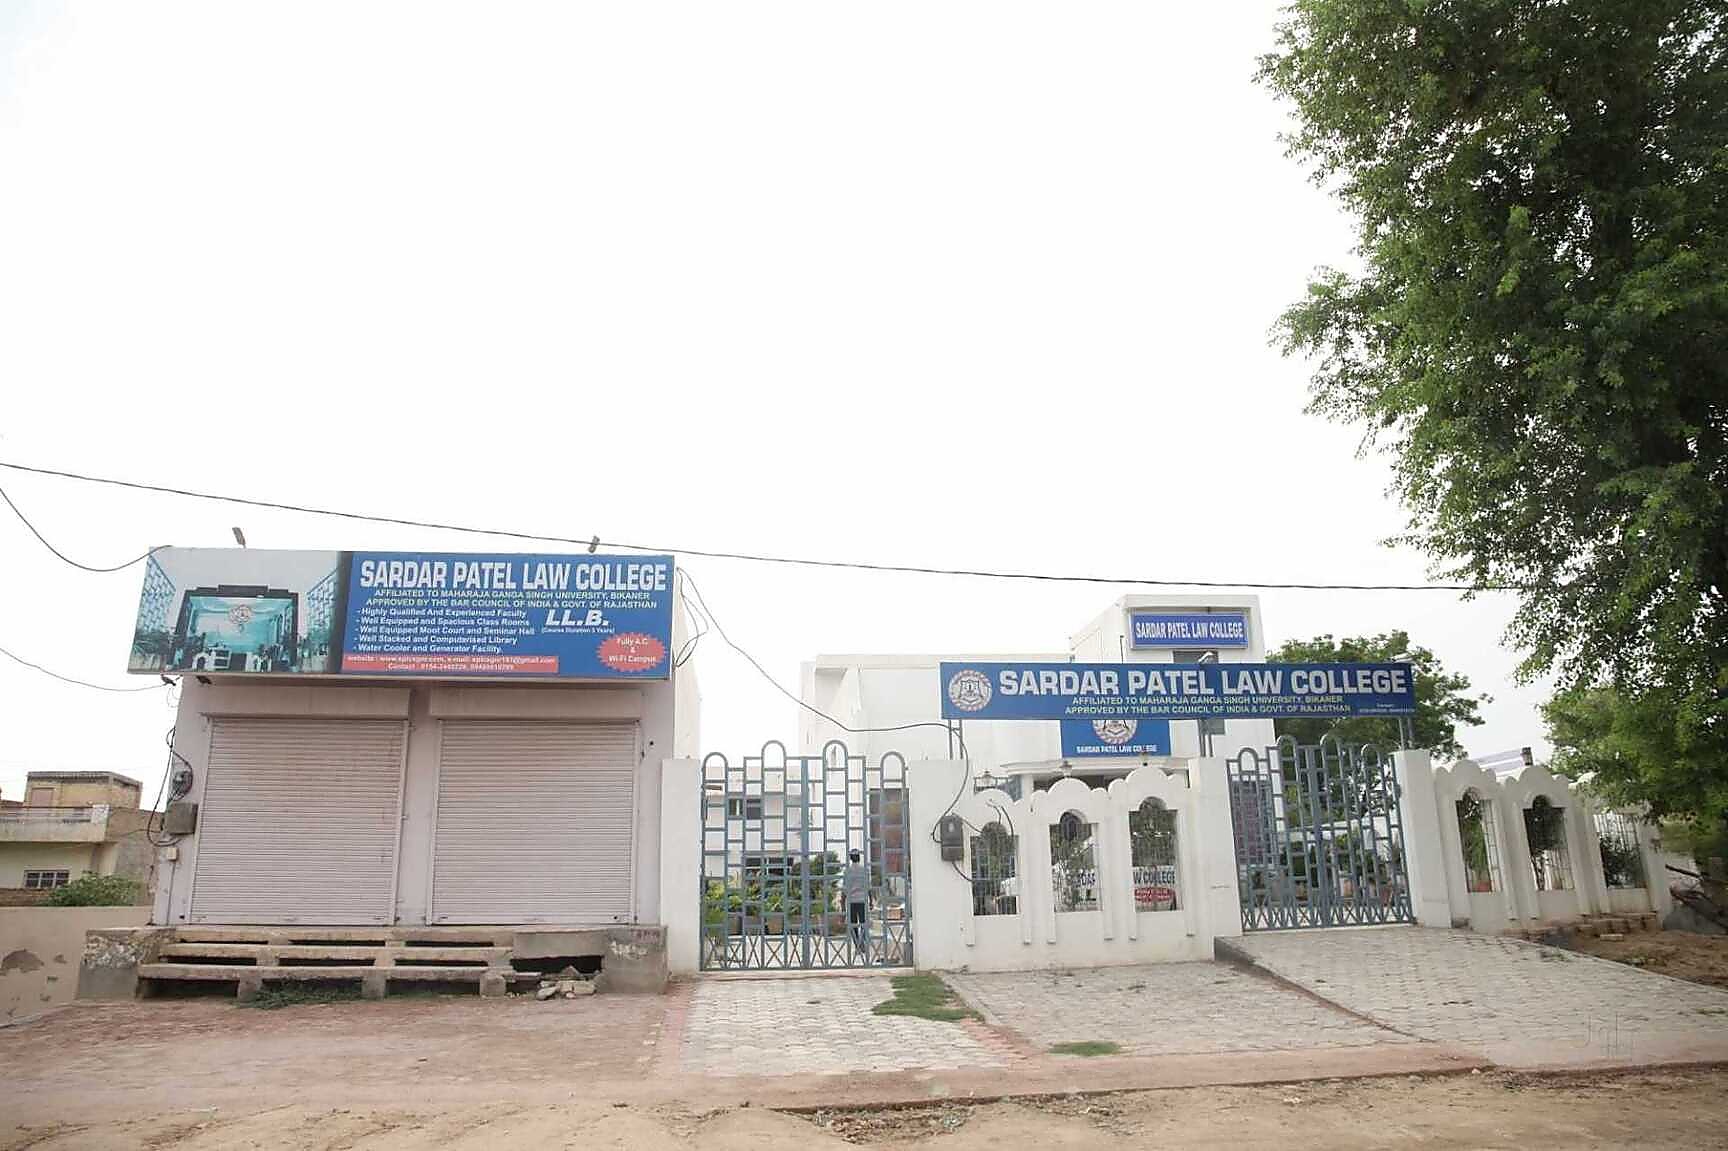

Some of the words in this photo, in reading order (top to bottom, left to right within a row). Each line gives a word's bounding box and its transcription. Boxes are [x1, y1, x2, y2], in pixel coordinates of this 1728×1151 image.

[360, 560, 447, 588] SARDAR
[453, 561, 517, 590] PATEL
[522, 562, 571, 591] LAW
[576, 563, 666, 592] COLLEGE
[374, 589, 425, 598] AFFILIATED
[427, 590, 439, 598] TO
[441, 590, 490, 599] MAHARAJA
[526, 591, 553, 600] SINGH
[610, 591, 650, 600] BIKANER
[366, 598, 414, 606] APPROVED
[415, 598, 428, 606] BY
[430, 599, 448, 607] THE
[471, 599, 512, 608] COUNCIL
[513, 599, 526, 608] OF
[527, 600, 551, 609] INDIA
[552, 600, 559, 608] &
[589, 601, 602, 609] OF
[603, 600, 657, 609] RAJASTHAN
[427, 608, 443, 616] And
[420, 617, 436, 625] and
[1135, 622, 1166, 639] SARDAR
[1167, 622, 1190, 639] PATEL
[1191, 622, 1209, 638] LAW
[1209, 621, 1244, 638] COLLEGE
[412, 644, 428, 652] and
[999, 670, 1119, 696] SARDAR
[1127, 670, 1214, 696] PATEL
[1221, 670, 1282, 695] LAW
[1291, 669, 1407, 695] COLLEGE
[1072, 696, 1123, 705] AFFILIATED
[1125, 696, 1137, 704] TO
[1139, 696, 1189, 705] MAHARAJA
[1190, 696, 1222, 704] GANGA
[1224, 696, 1250, 704] SINGH
[1304, 695, 1343, 704] BIKANER
[1065, 706, 1113, 714] APPROVED
[1116, 706, 1129, 714] BY
[1131, 706, 1149, 714] THE
[1151, 705, 1170, 714] BAR
[1171, 705, 1207, 714] COUNCIL
[1208, 705, 1224, 714] OF
[1226, 705, 1250, 714] INDIA
[1251, 705, 1258, 713] &
[1286, 705, 1298, 713] OF
[1300, 704, 1350, 713] RAJASTHAN
[1076, 745, 1101, 754] SARDAR
[1101, 745, 1118, 753] PATEL
[1119, 745, 1132, 753] LAW
